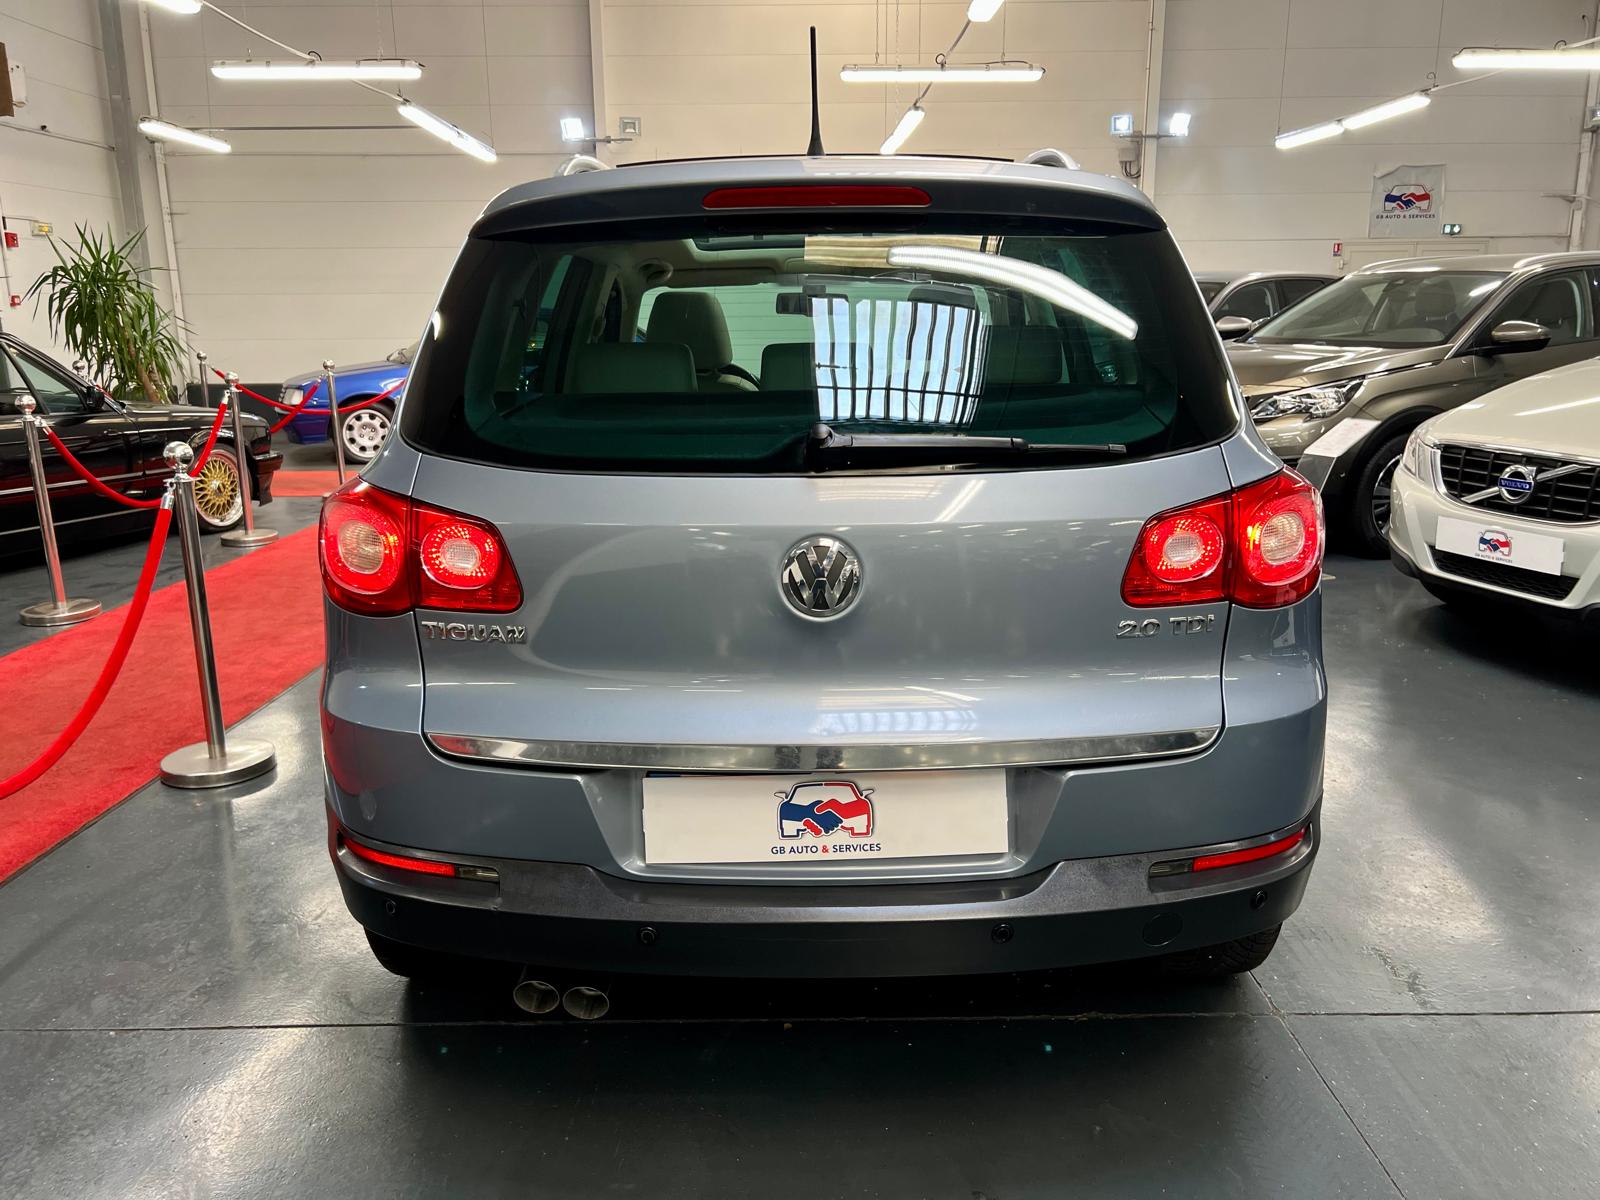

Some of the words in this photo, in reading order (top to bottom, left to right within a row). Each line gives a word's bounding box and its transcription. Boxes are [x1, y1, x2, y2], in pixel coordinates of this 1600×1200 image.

[1500, 479, 1529, 489] VOLVO
[421, 621, 526, 643] TIGUAN
[1169, 614, 1215, 635] TDI
[771, 846, 785, 854] GB
[789, 845, 818, 854] AUTO
[821, 845, 829, 854] &
[832, 843, 881, 853] SERVICES
